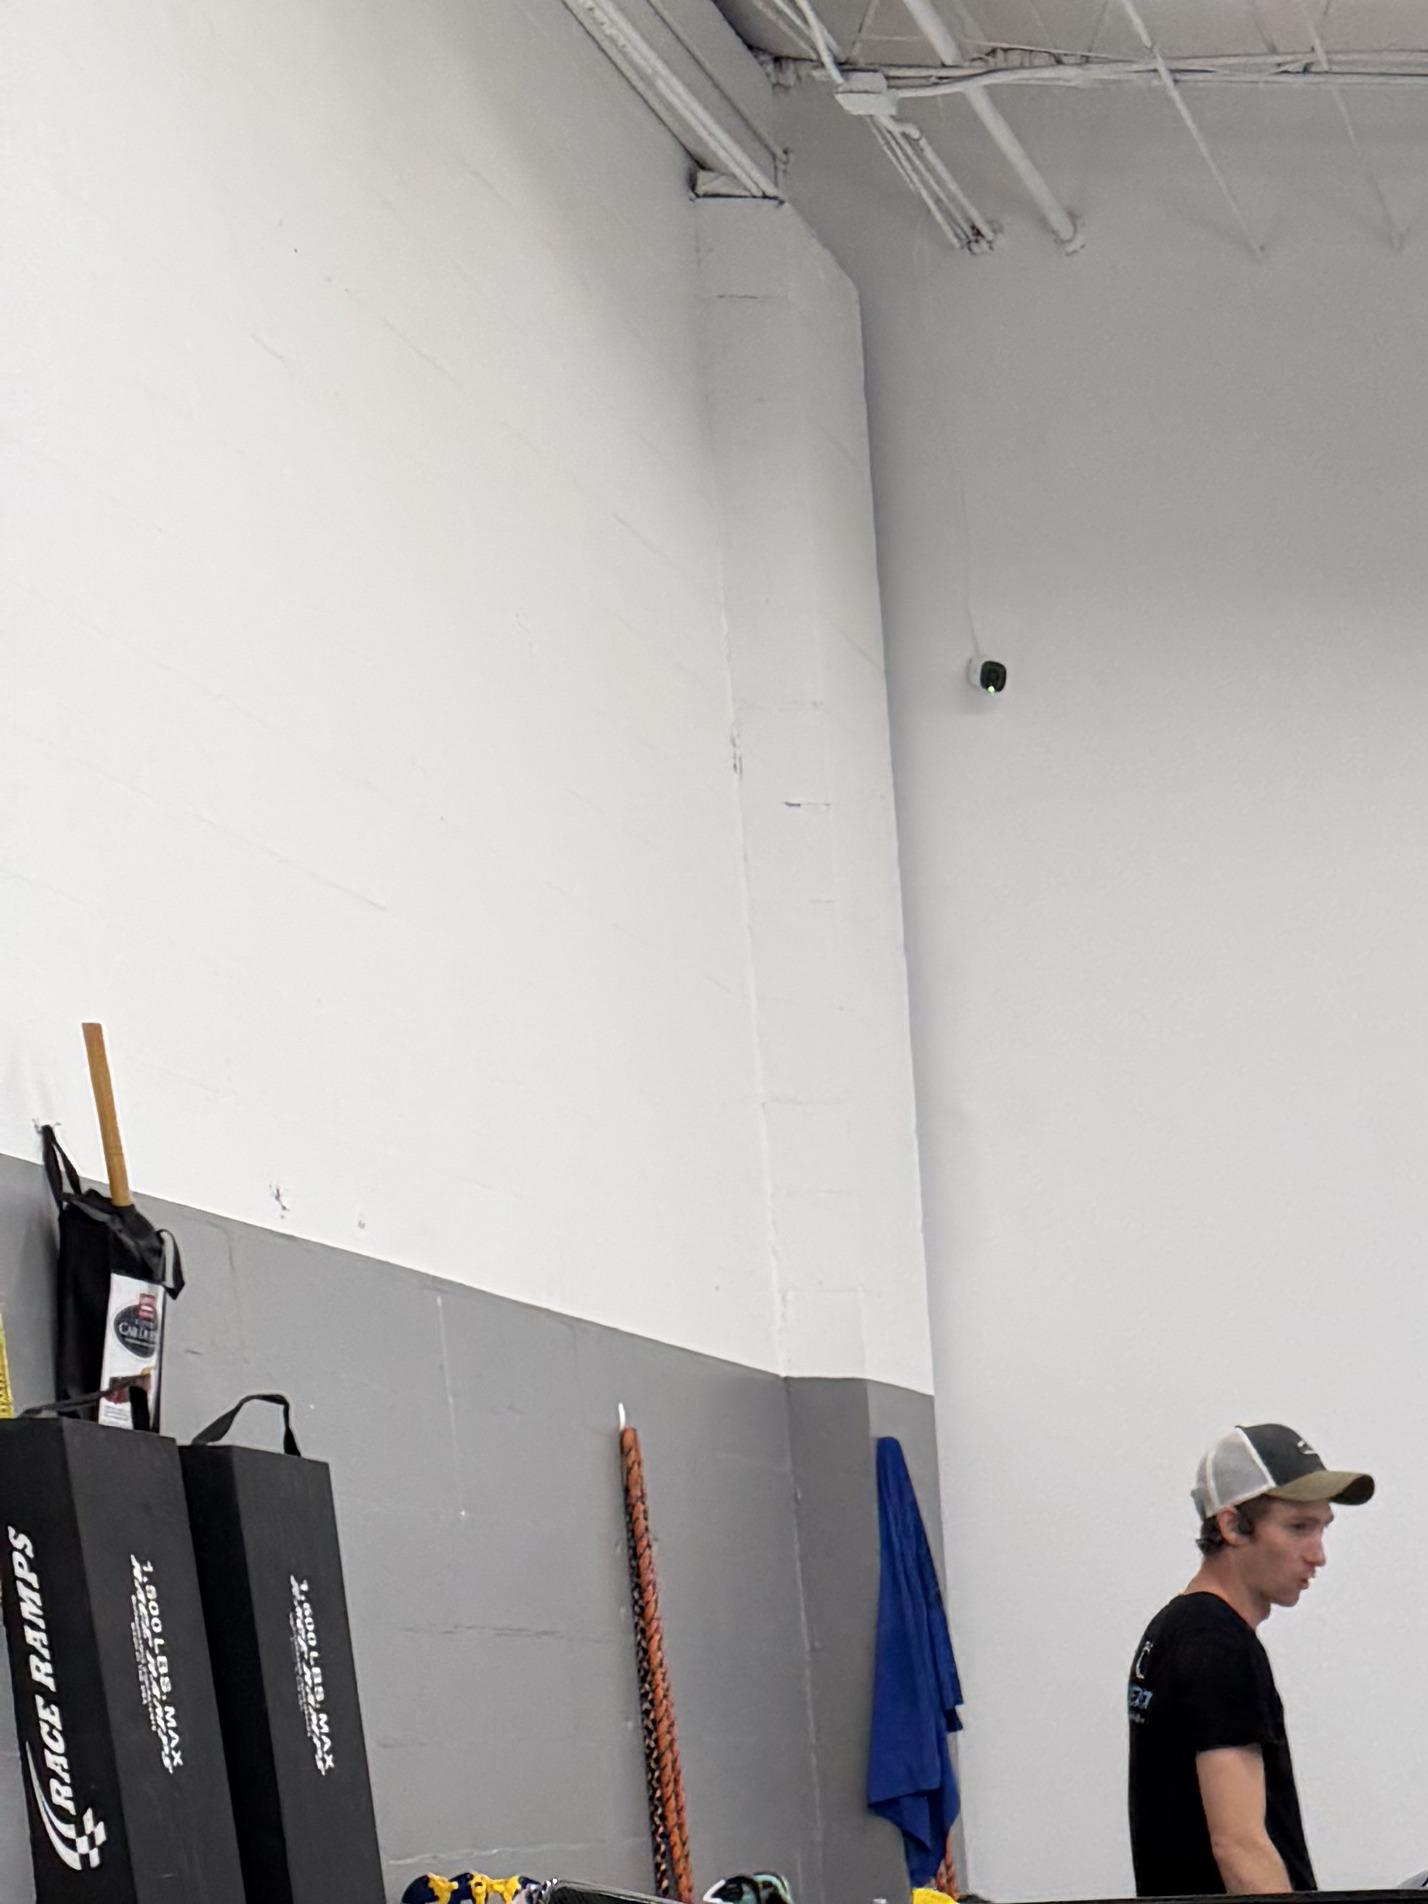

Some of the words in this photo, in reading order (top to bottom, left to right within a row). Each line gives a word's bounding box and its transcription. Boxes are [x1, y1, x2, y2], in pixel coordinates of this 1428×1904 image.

[7, 1525, 57, 1693] RAMPS
[35, 1693, 77, 1817] RACE
[164, 1705, 184, 1767] MAX
[318, 1712, 335, 1769] MAX
